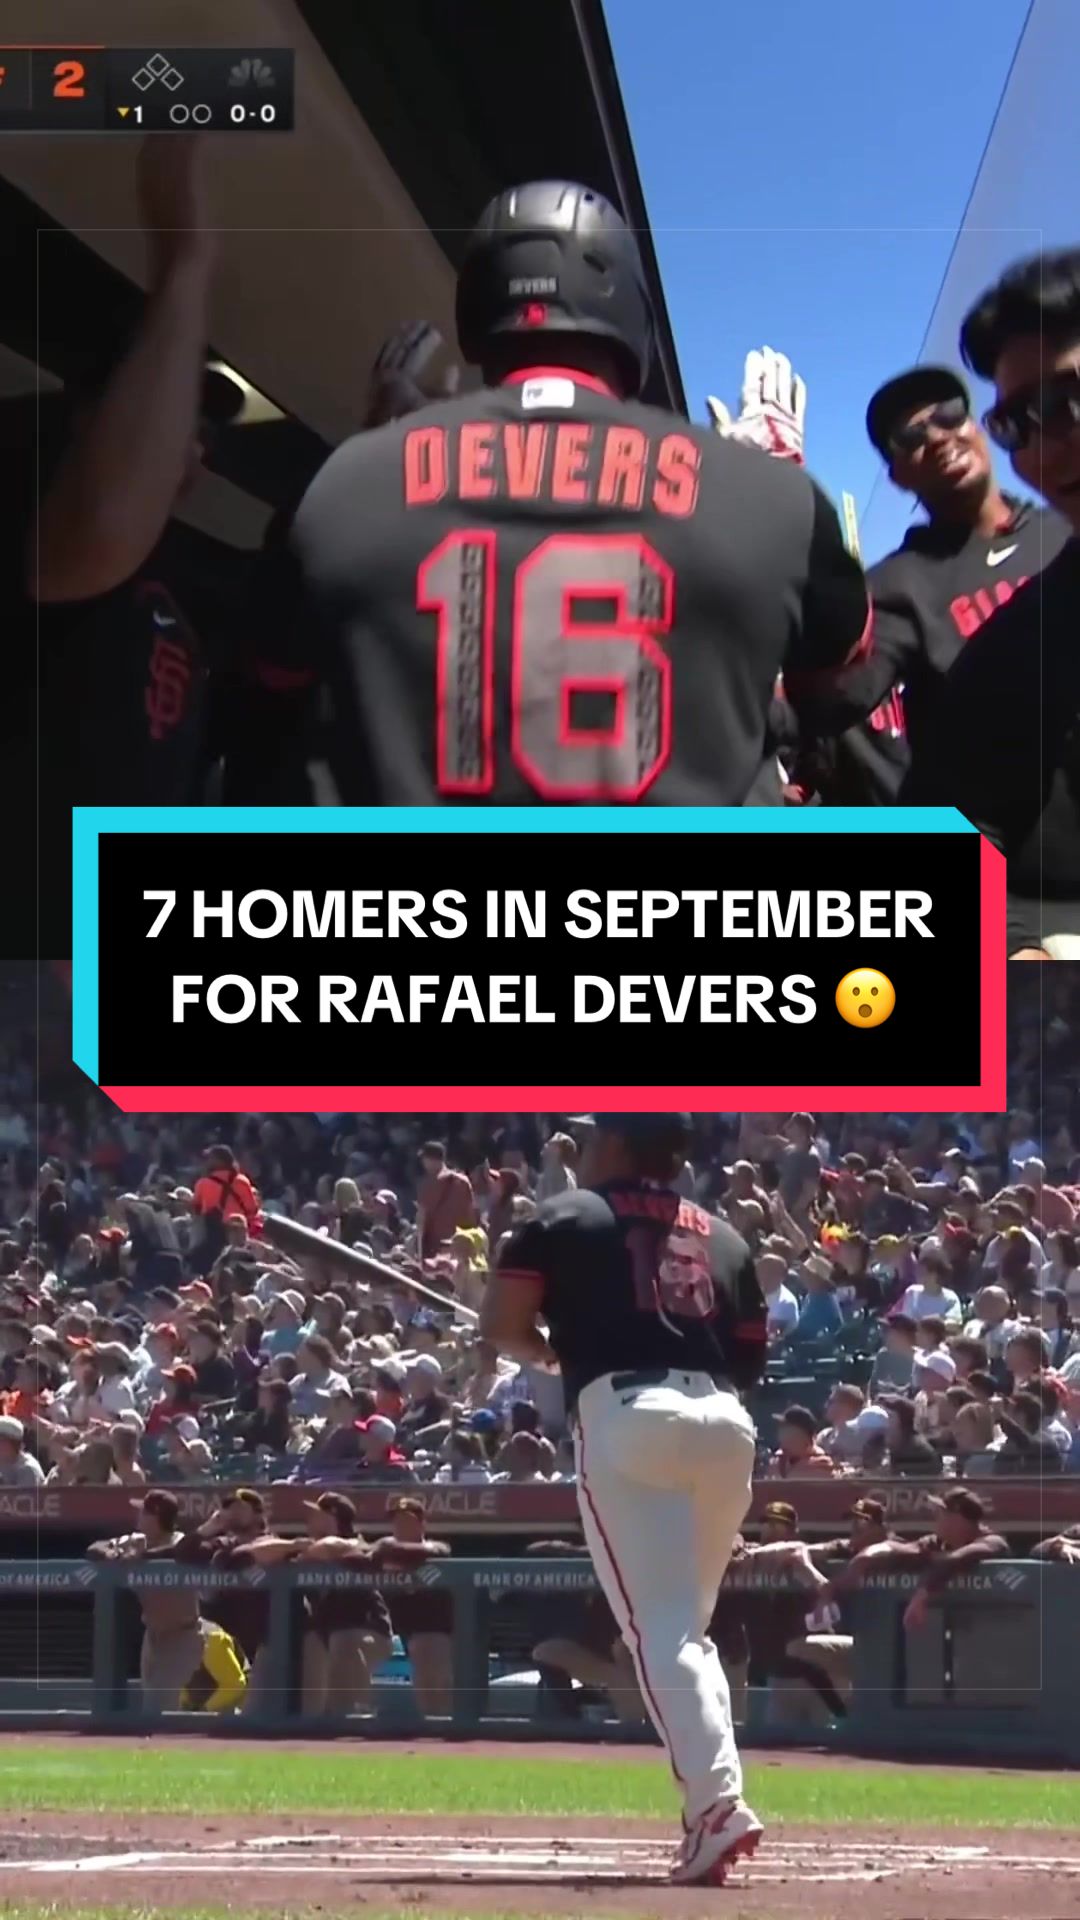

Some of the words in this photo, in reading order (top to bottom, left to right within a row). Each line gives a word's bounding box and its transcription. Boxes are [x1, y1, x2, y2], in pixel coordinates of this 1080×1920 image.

[404, 423, 702, 520] DEVERS
[416, 529, 676, 801] 16
[127, 1572, 161, 1586] BANK
[163, 1572, 179, 1586] OF
[184, 1572, 239, 1586] AMERICA
[297, 1572, 331, 1586] BANK
[335, 1571, 350, 1586] OF
[354, 1572, 413, 1586] AMERICA
[473, 1572, 511, 1587] BANK
[513, 1573, 531, 1586] OF
[534, 1573, 597, 1586] AMERICA
[859, 1574, 896, 1588] ANK
